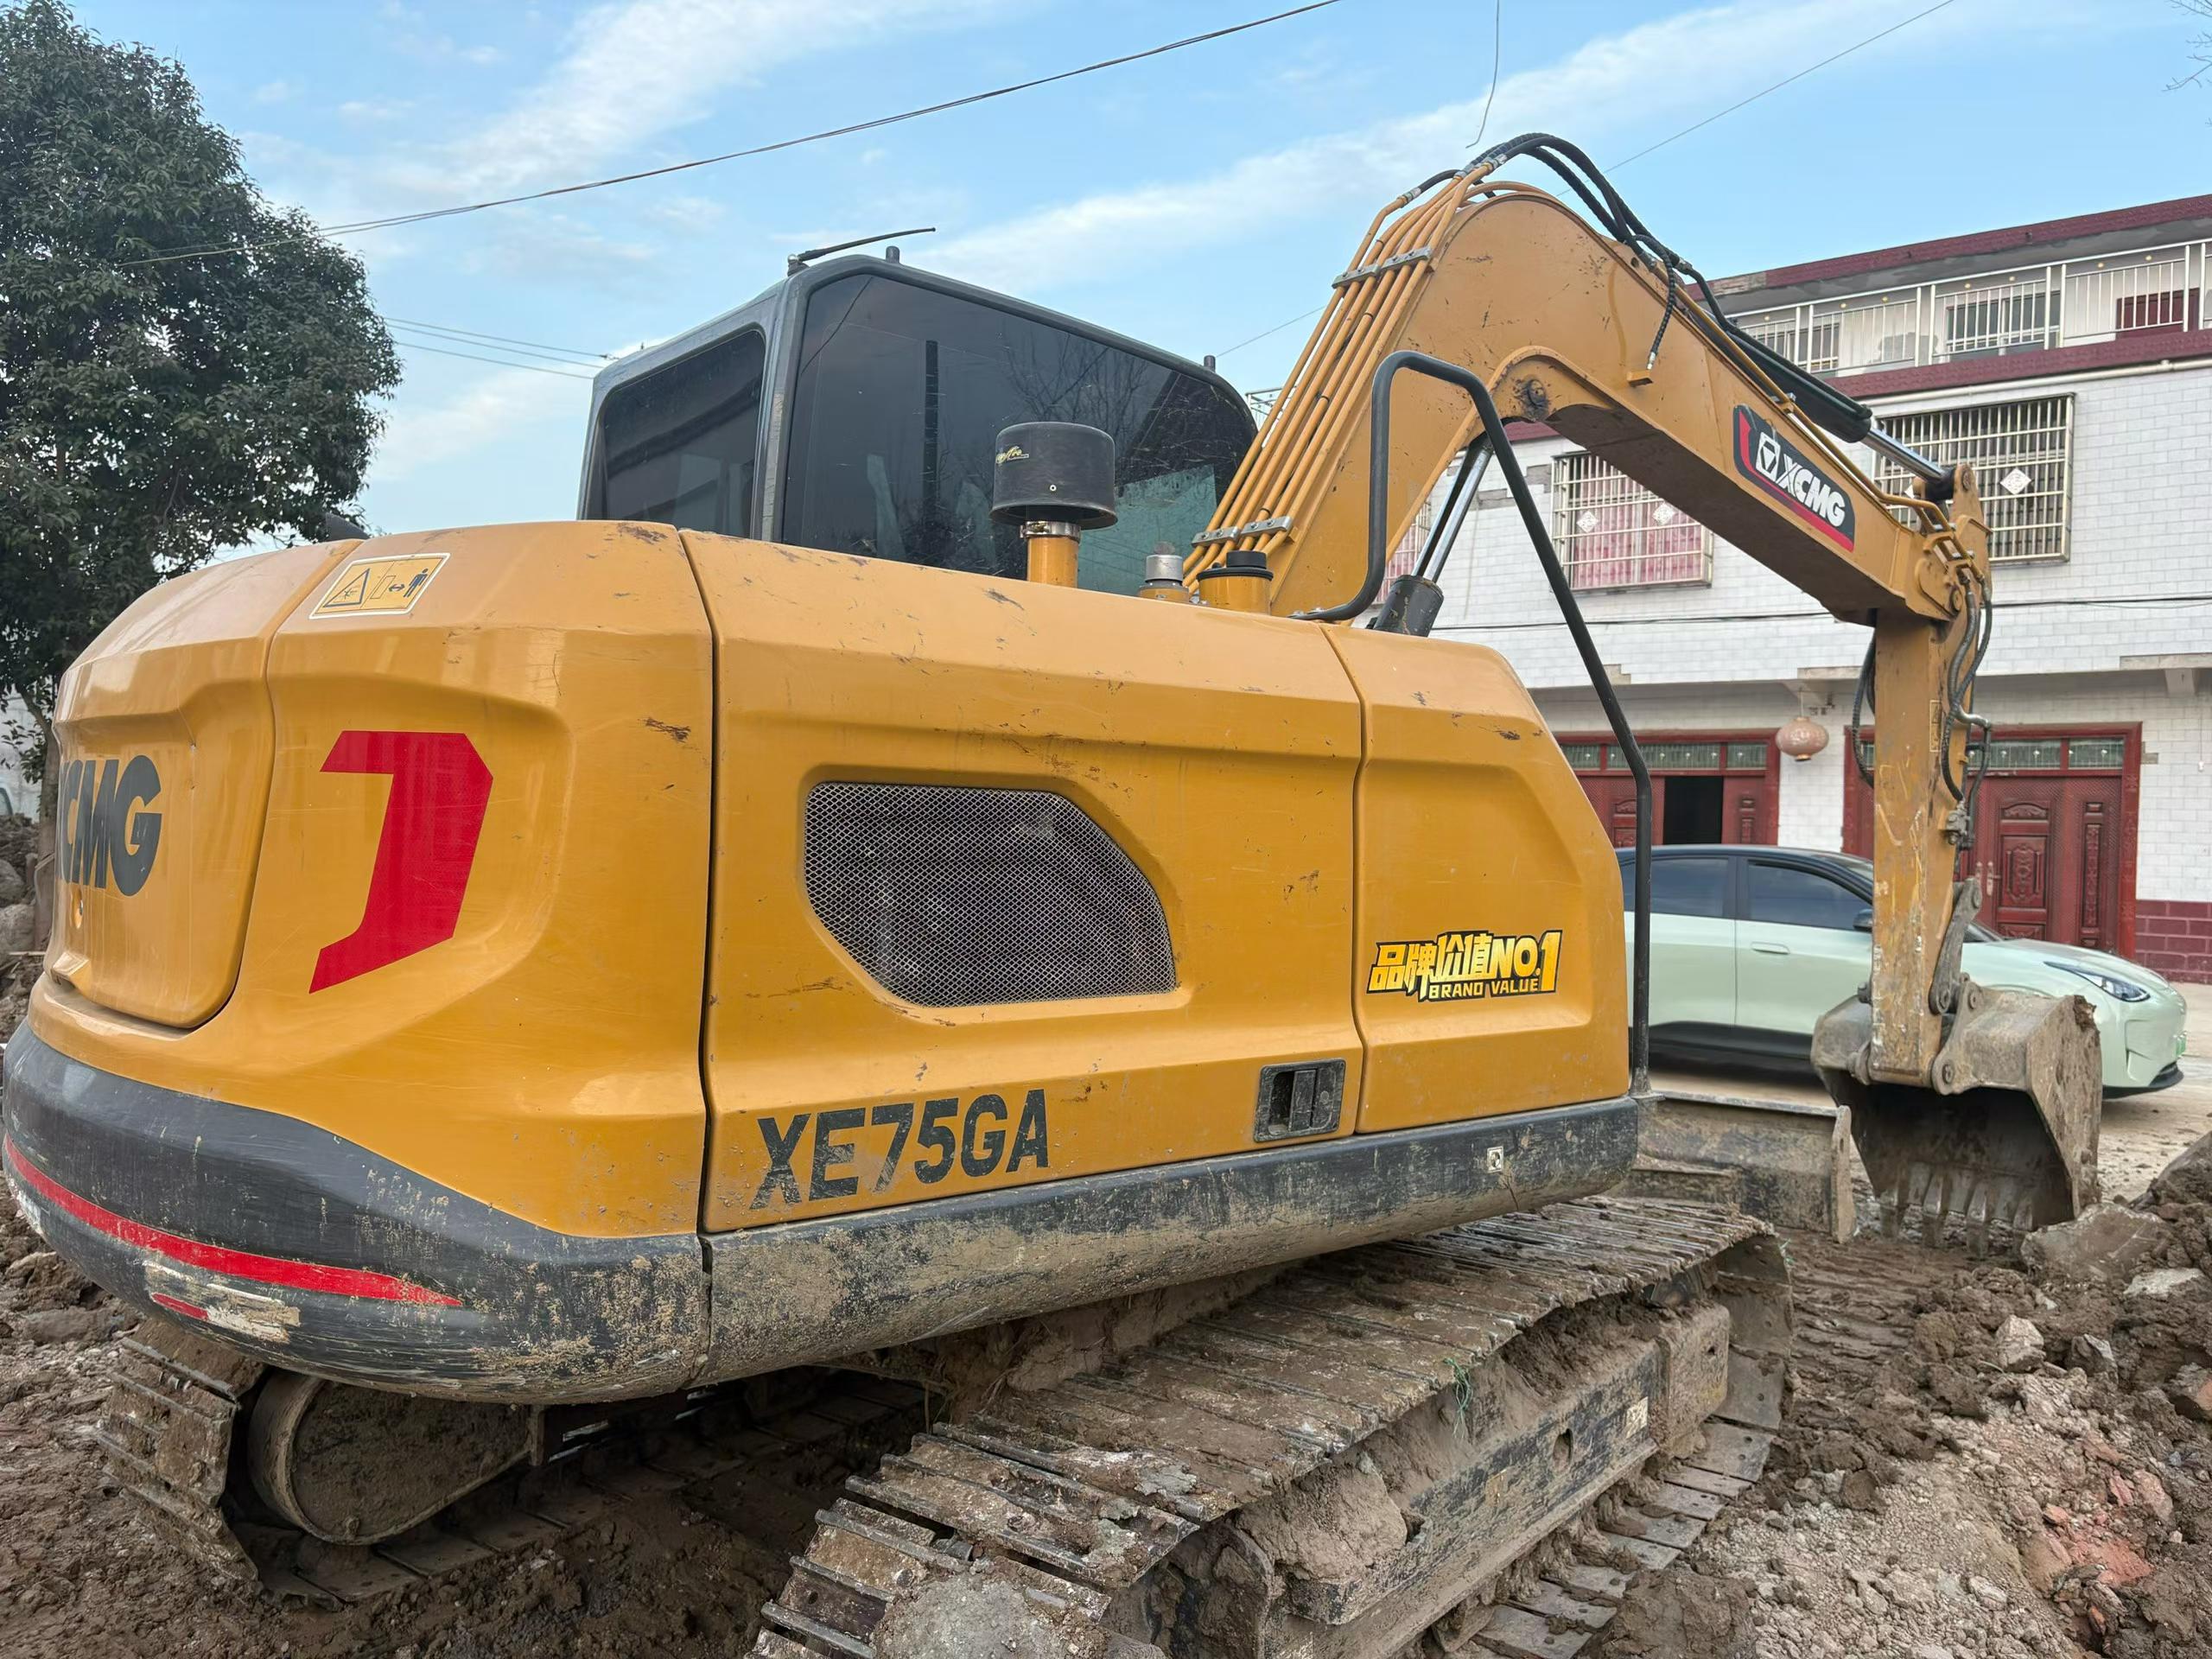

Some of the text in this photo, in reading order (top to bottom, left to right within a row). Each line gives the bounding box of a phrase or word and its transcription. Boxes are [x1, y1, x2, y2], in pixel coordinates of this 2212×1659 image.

[1776, 454, 1846, 527] XCMG
[60, 754, 162, 897] CMG
[1428, 978, 1538, 999] BRAND VALUE
[749, 1089, 1049, 1211] XE75GA
